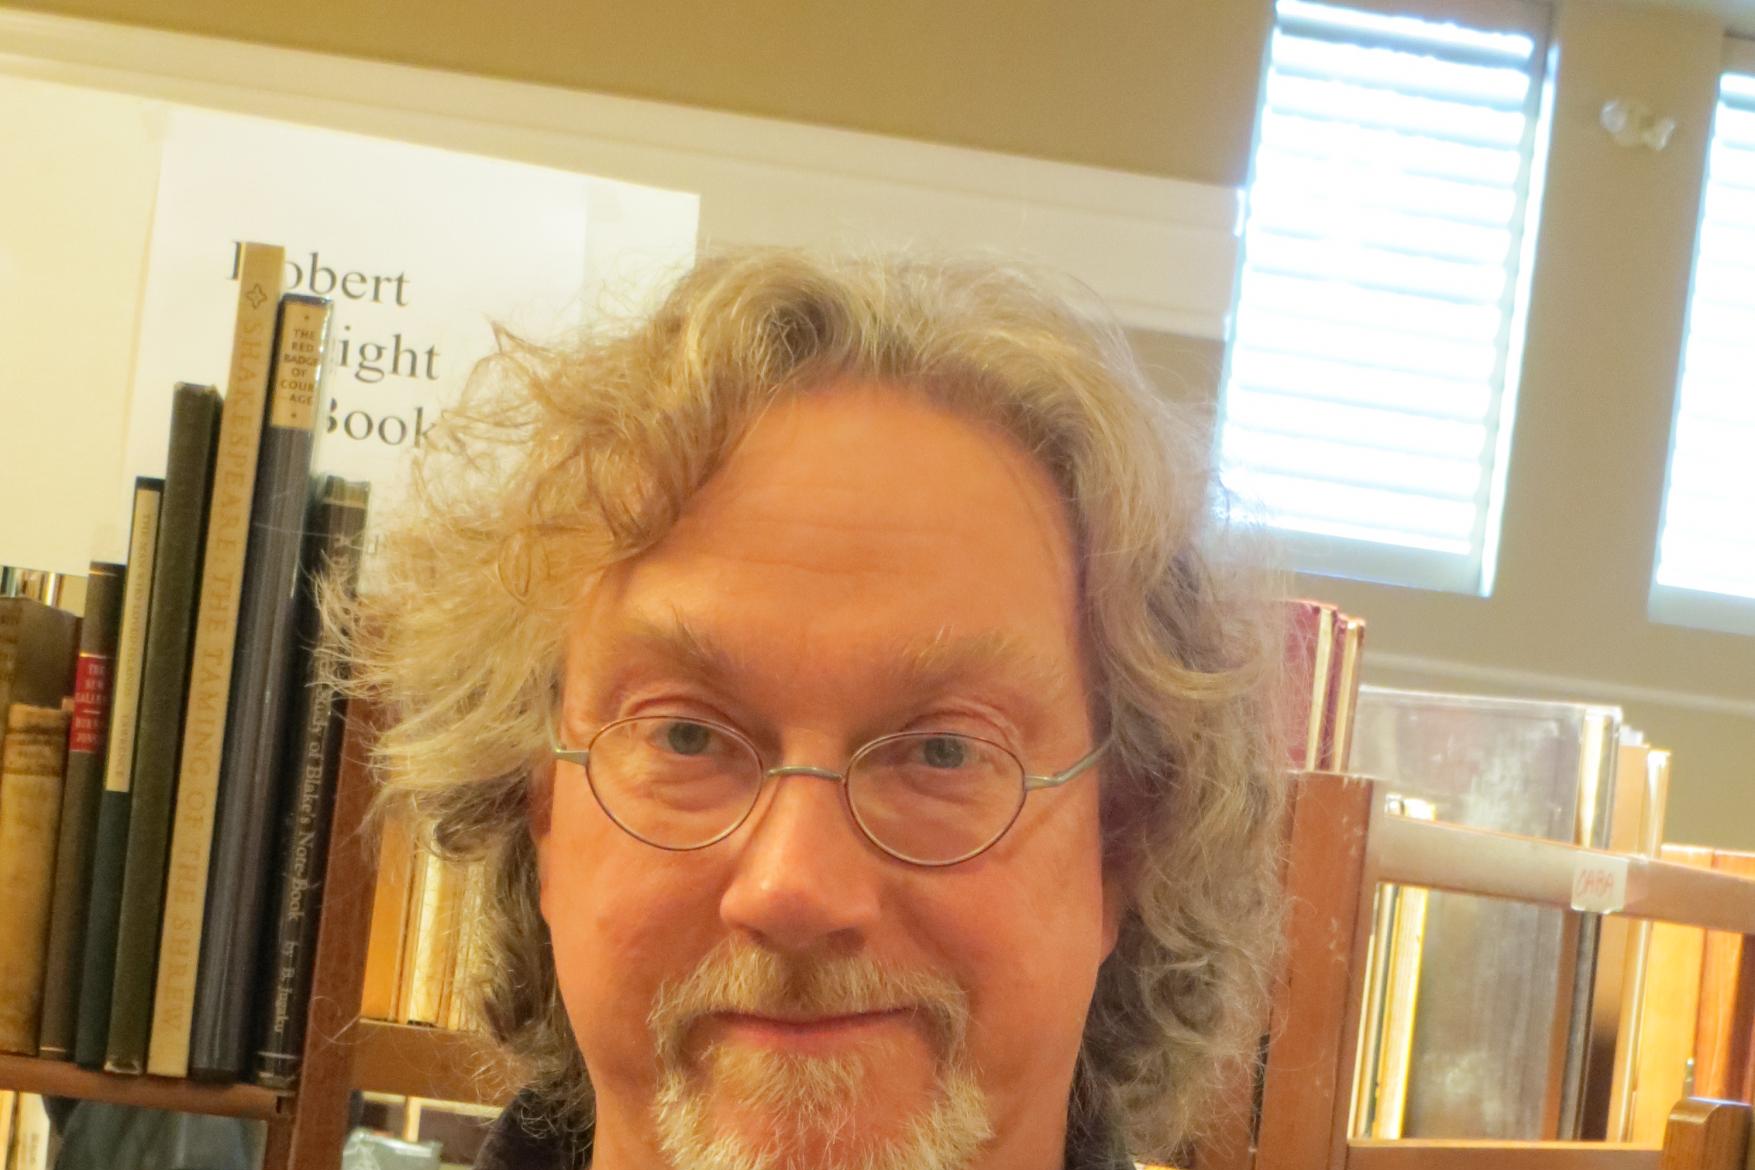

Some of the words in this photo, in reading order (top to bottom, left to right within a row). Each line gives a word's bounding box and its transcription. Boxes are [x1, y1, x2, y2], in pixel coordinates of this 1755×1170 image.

[228, 241, 410, 308] obert
[291, 341, 315, 353] RED
[293, 328, 316, 341] THE
[338, 325, 439, 384] ight
[283, 353, 319, 368] BADGE
[291, 366, 308, 378] OF
[289, 393, 314, 407] AGE
[206, 573, 234, 633] THE
[188, 647, 225, 778] TAMING
[307, 741, 324, 762] of
[183, 791, 206, 831] OF
[299, 765, 323, 826] Blake's
[173, 847, 201, 902] THE
[287, 831, 316, 922] Note-Book
[161, 912, 194, 1031] SHREW
[281, 940, 299, 957] by
